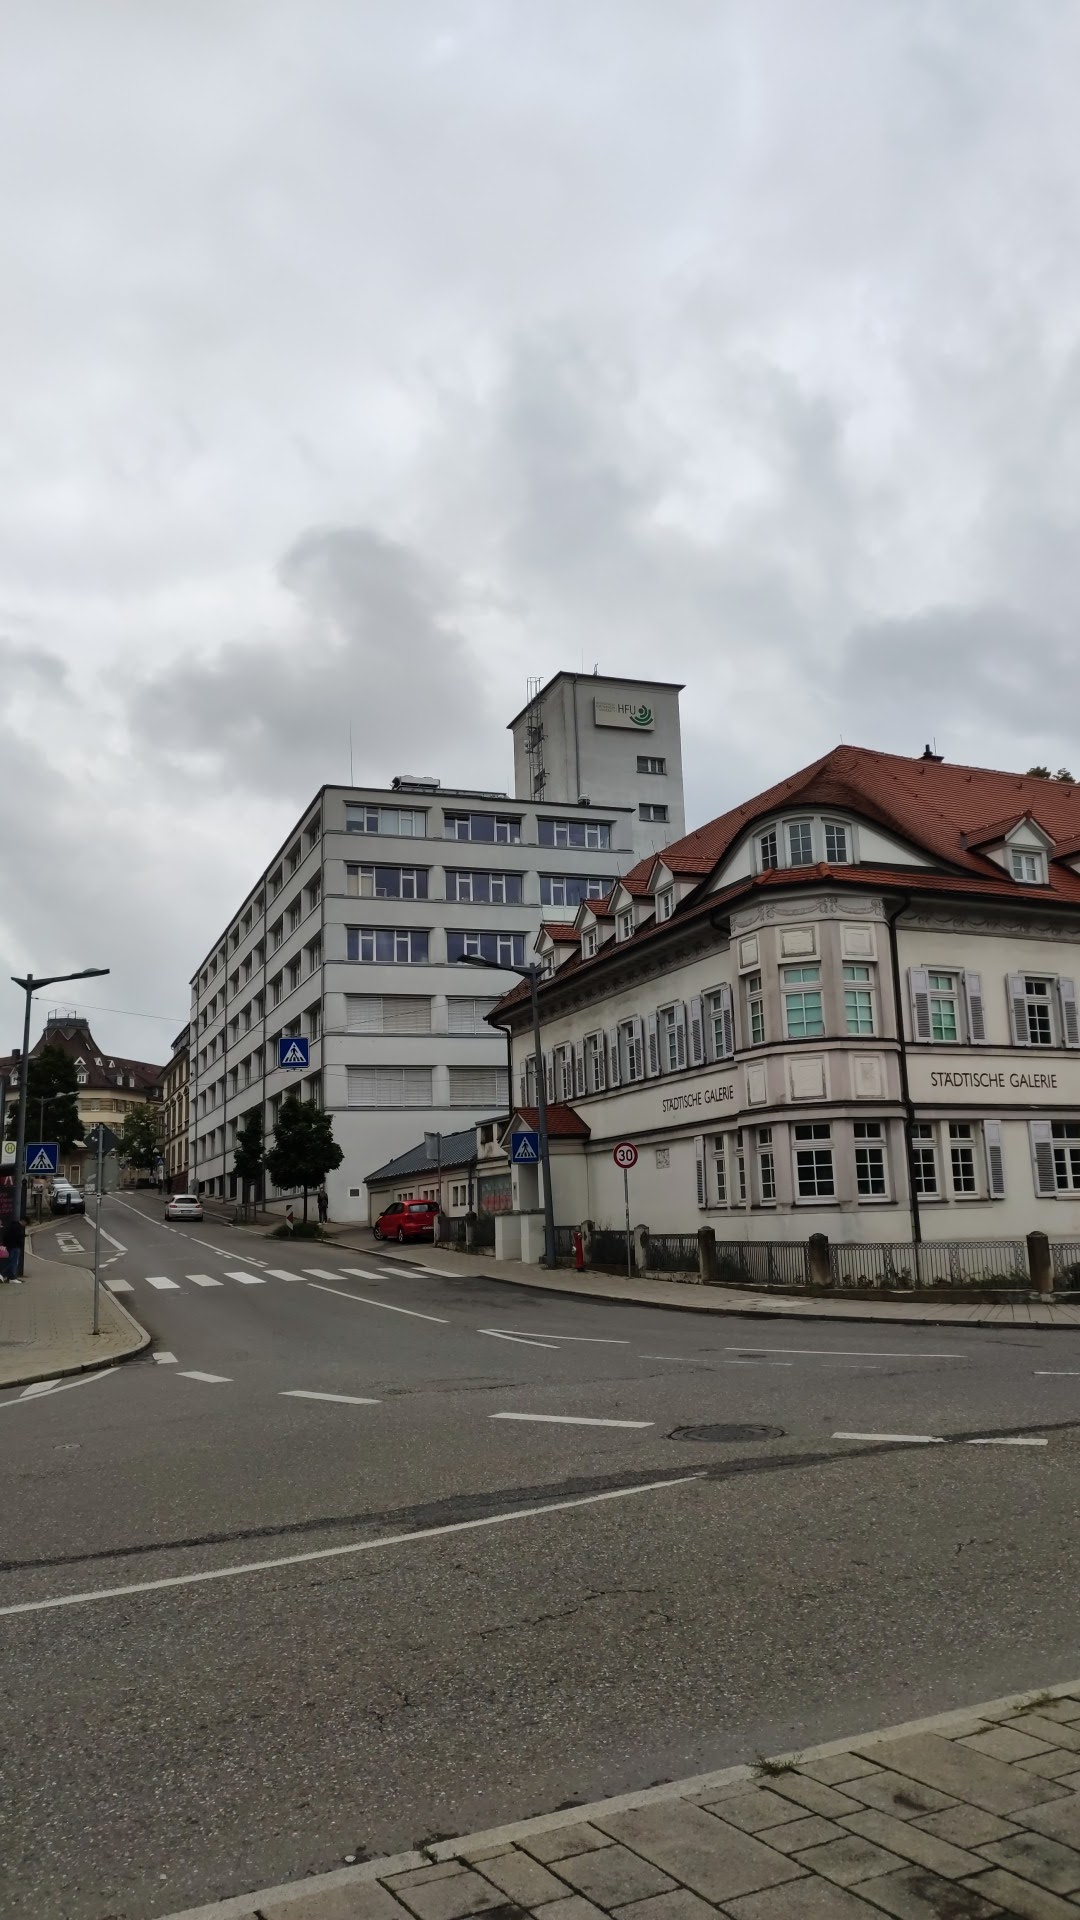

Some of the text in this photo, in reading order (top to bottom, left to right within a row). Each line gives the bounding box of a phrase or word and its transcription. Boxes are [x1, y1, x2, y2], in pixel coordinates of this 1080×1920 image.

[617, 703, 636, 715] HFU
[930, 1071, 1058, 1089] STÄDTISCHE GALERIE
[662, 1085, 734, 1113] STÄDTISCHE GALERIE
[618, 1149, 633, 1161] 30
